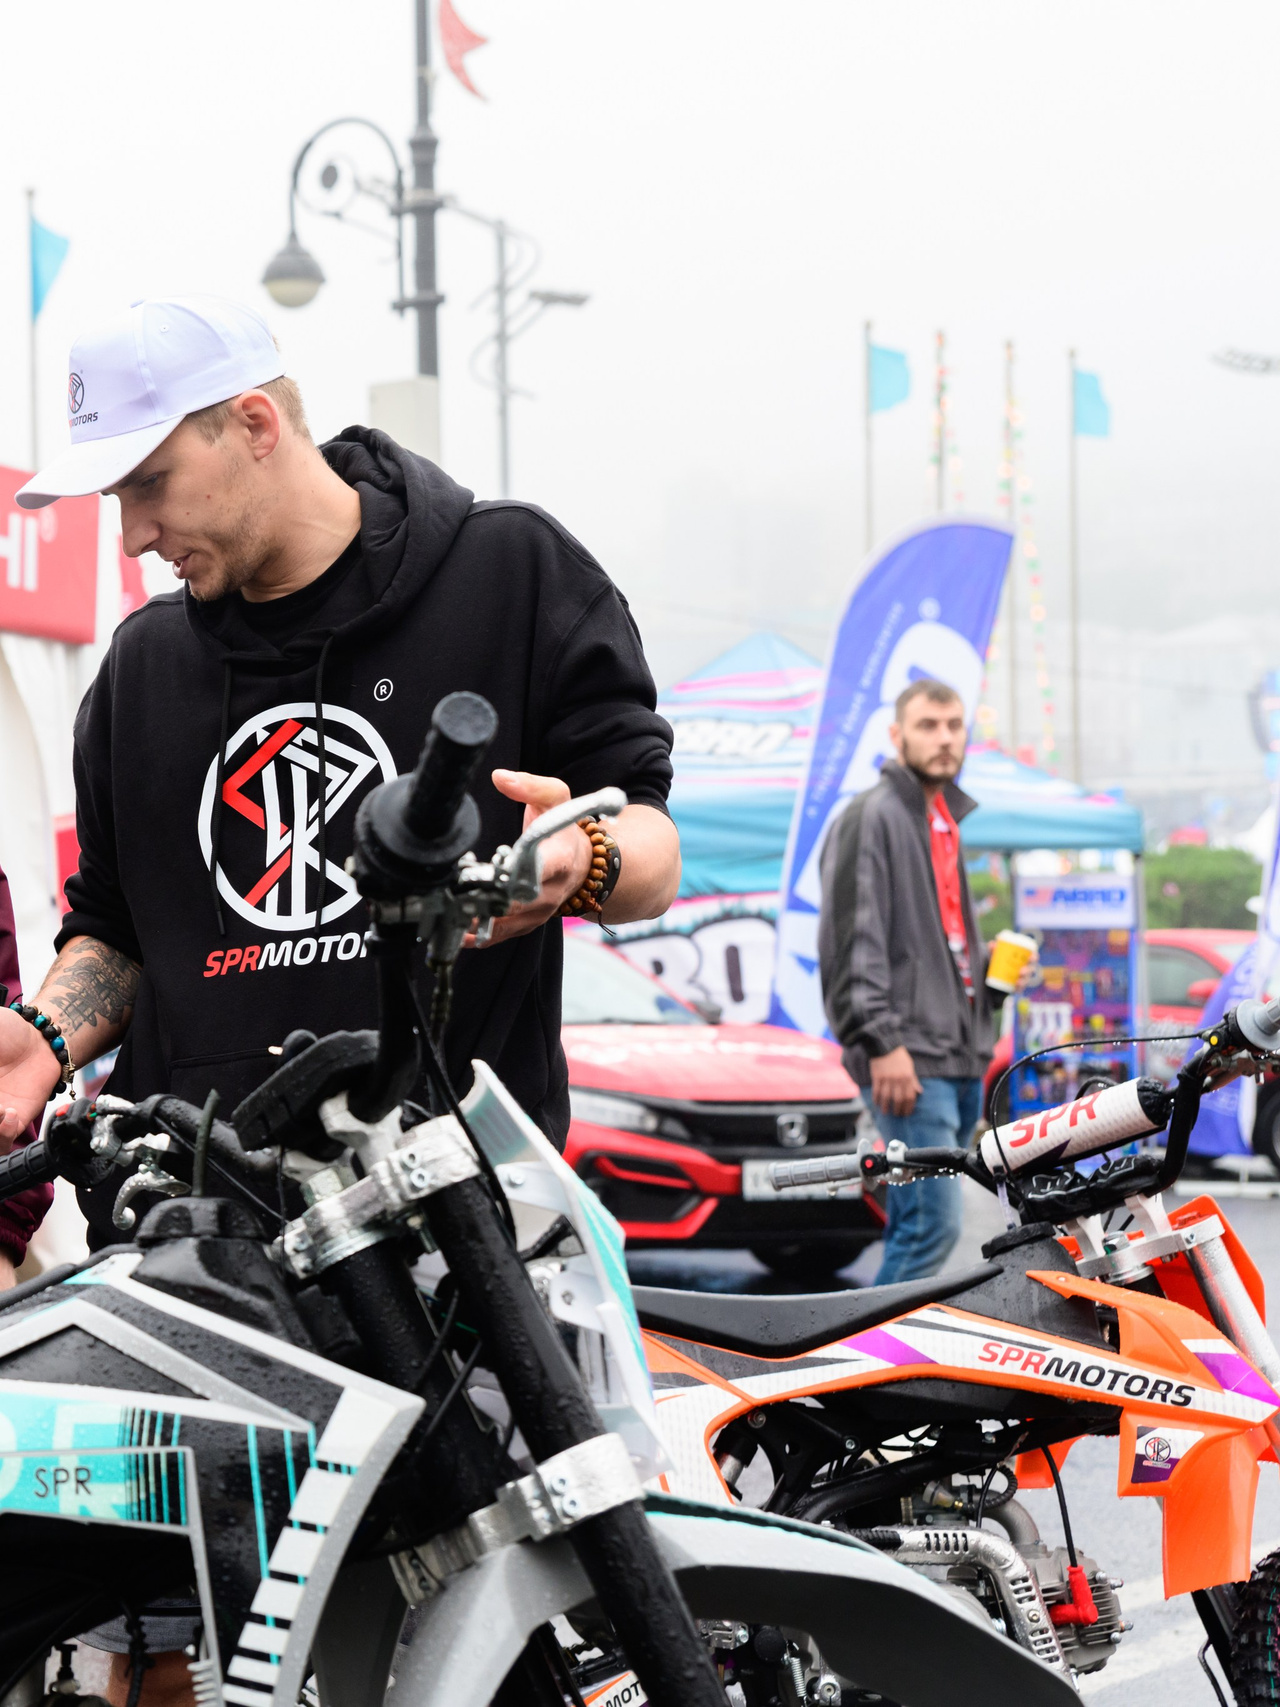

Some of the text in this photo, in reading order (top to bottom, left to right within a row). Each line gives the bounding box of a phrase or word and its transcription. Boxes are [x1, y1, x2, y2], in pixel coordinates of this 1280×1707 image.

[1009, 1090, 1102, 1148] SPR
[977, 1341, 1196, 1407] SPRMOTORS
[34, 1466, 93, 1498] SPR
